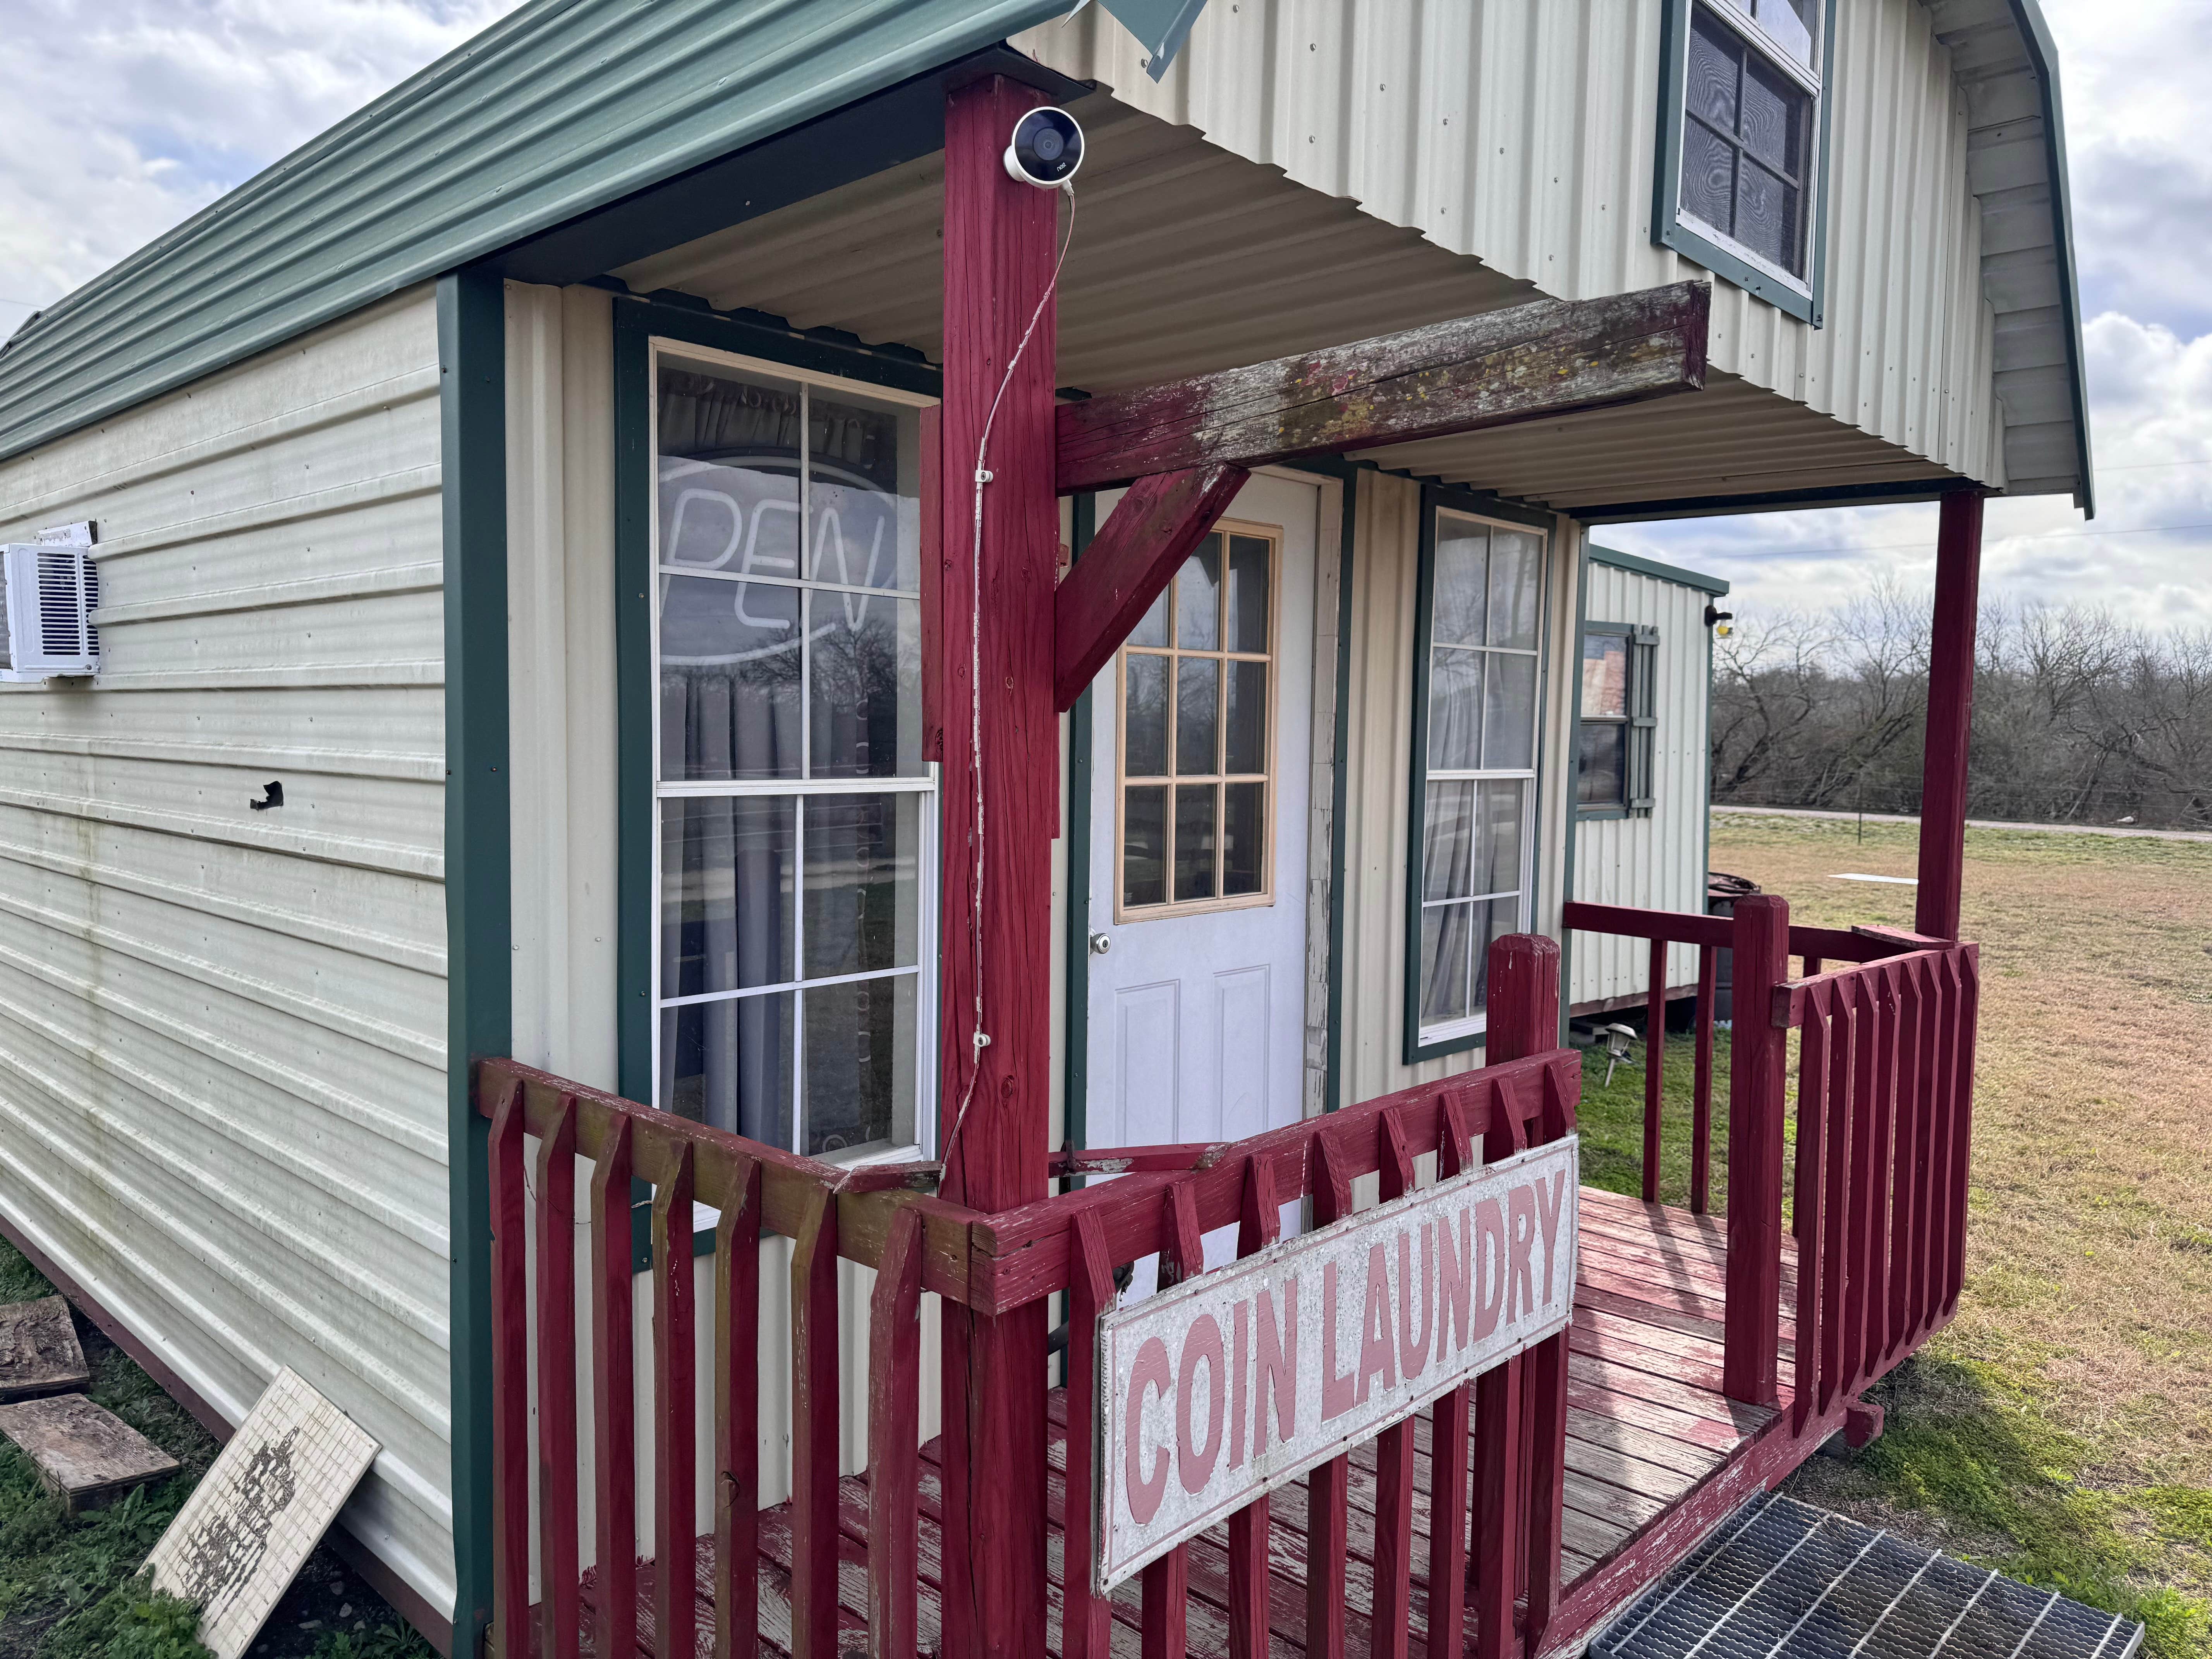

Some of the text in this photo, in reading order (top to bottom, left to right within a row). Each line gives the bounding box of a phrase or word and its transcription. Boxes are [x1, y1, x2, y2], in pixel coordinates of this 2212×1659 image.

[659, 488, 885, 632] PEN
[1125, 1169, 1566, 1525] COIN LAUNDRY
